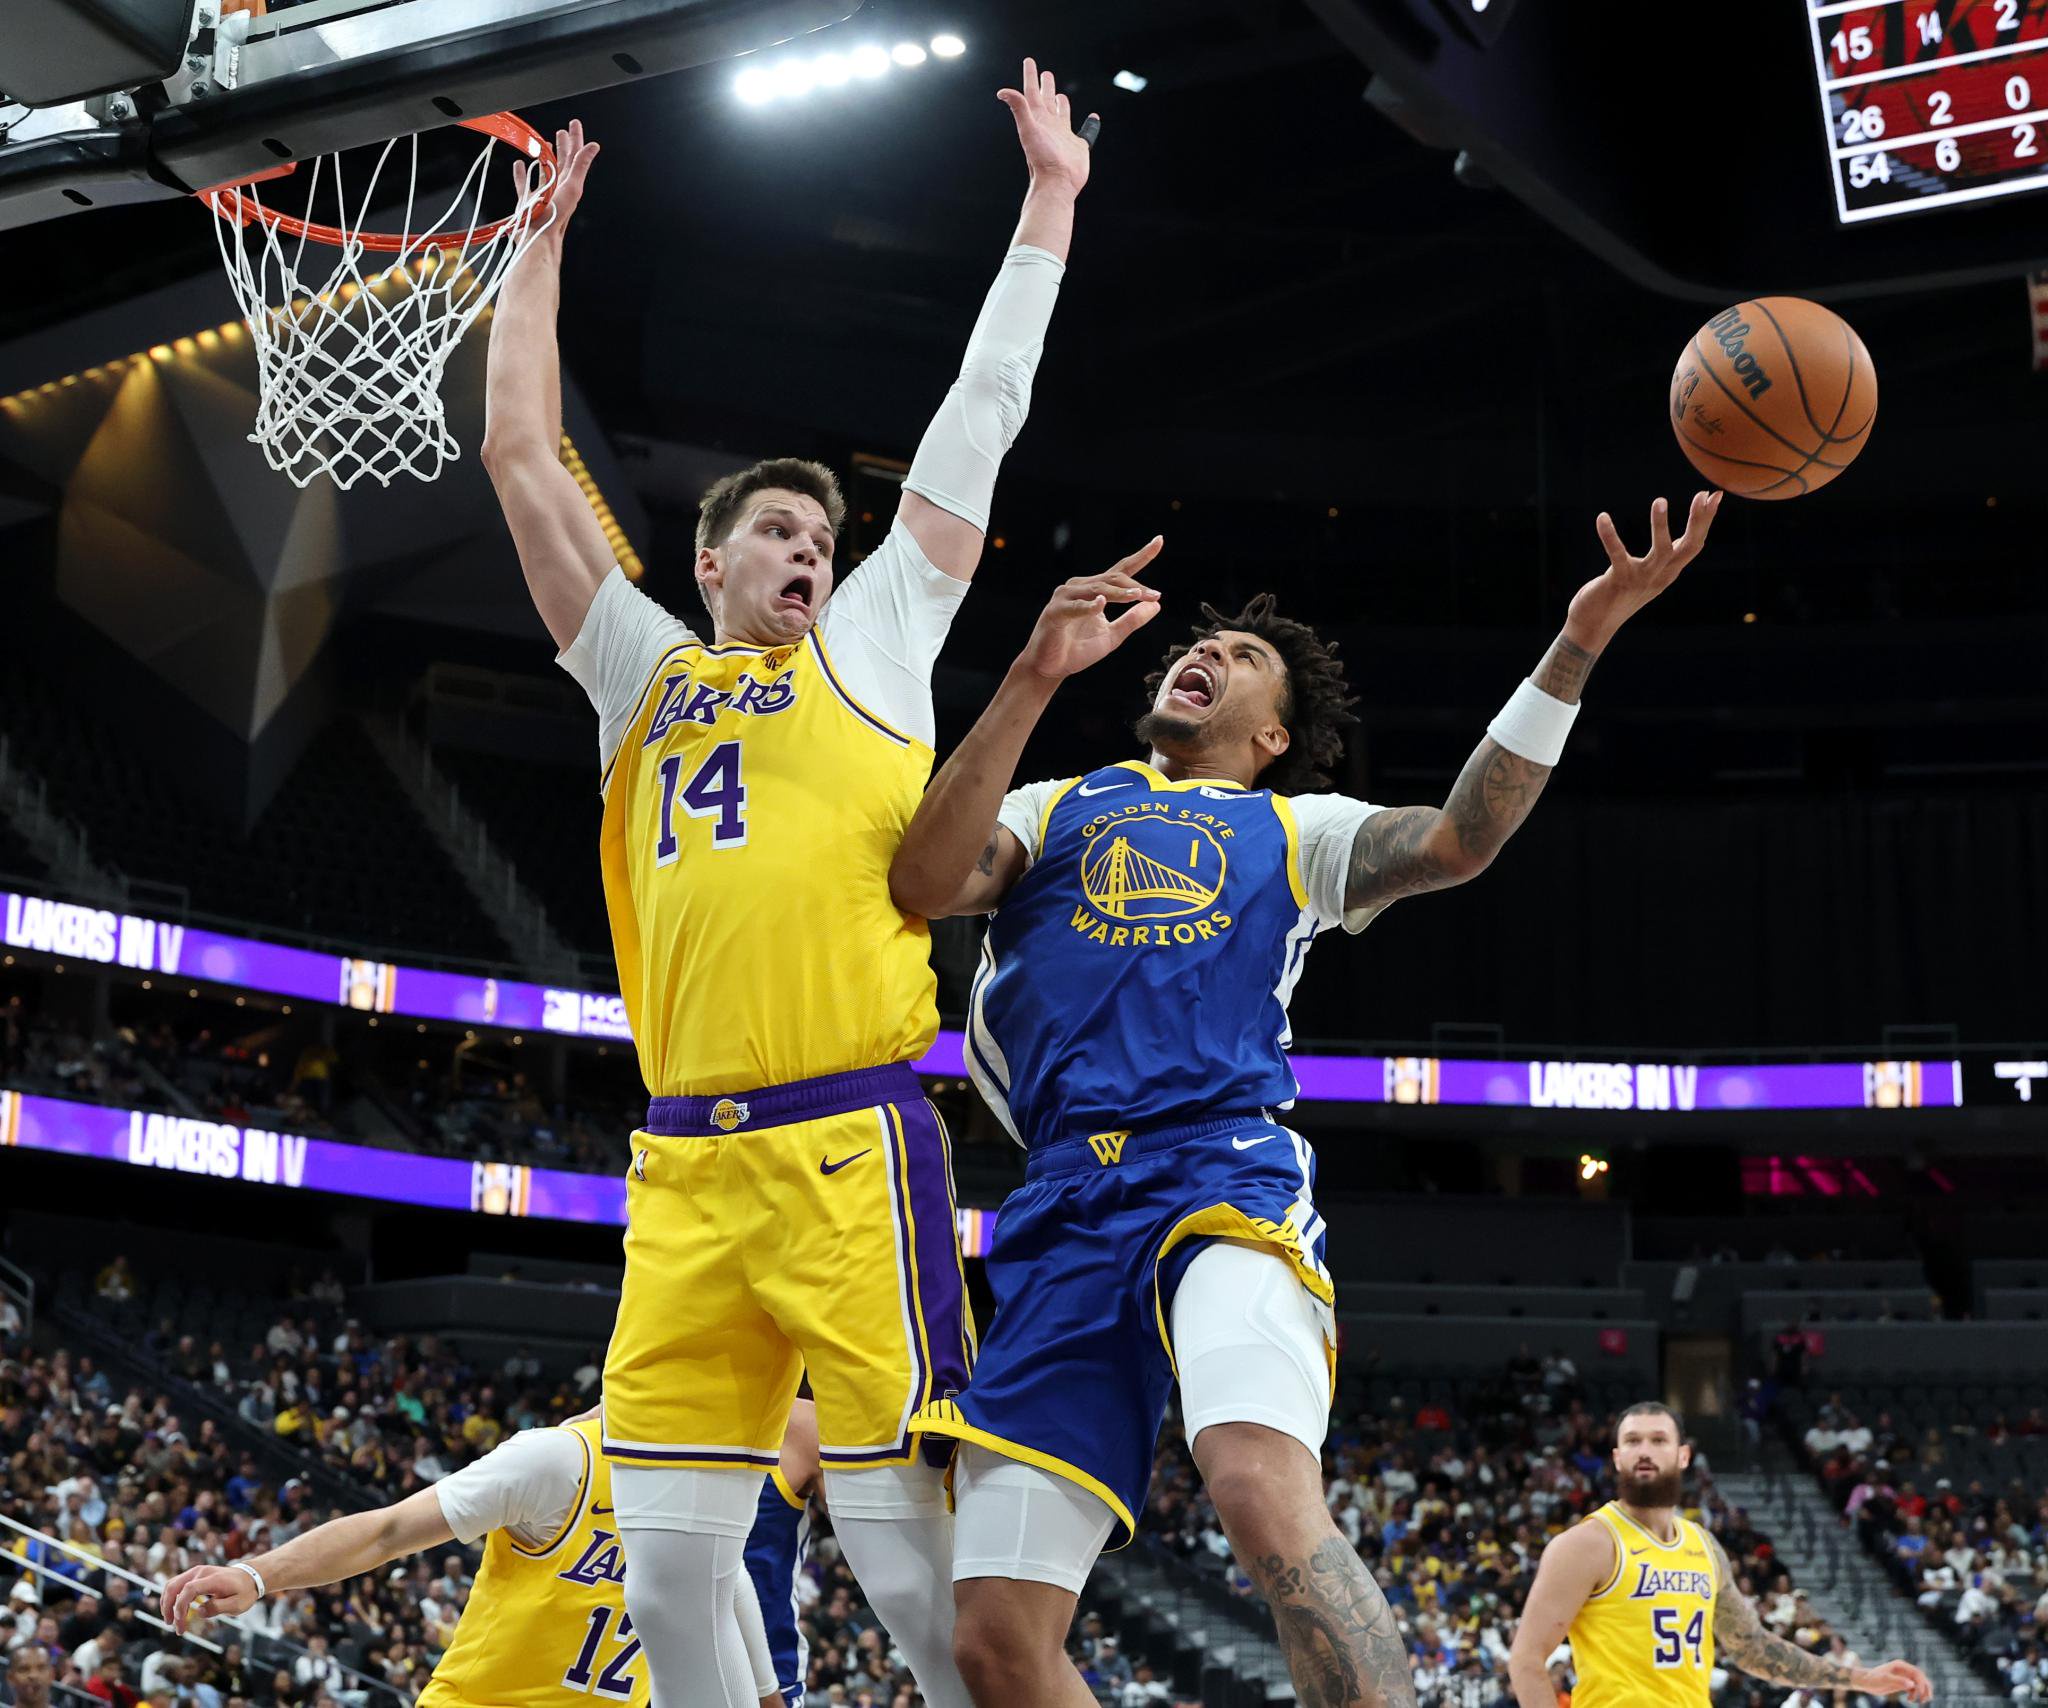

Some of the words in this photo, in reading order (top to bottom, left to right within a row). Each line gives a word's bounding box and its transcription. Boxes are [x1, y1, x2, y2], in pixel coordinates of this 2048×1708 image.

[1830, 26, 1873, 63] 15
[1916, 10, 1943, 46] 14
[1993, 0, 2020, 31] 2
[1841, 105, 1885, 143] 26
[1927, 90, 1954, 126] 2
[2005, 76, 2031, 110] 0
[1848, 151, 1891, 188] 54
[1935, 137, 1961, 171] 6
[2011, 123, 2038, 158] 2
[655, 740, 748, 870] 14
[1081, 802, 1170, 838] GOLDEN
[1178, 808, 1236, 841] STATE
[1189, 839, 1200, 868] 1
[5, 893, 118, 963] LAKERS
[118, 914, 156, 971] IN
[158, 922, 185, 975] V
[1069, 904, 1233, 946] WARRIORS
[1529, 1060, 1633, 1110] LAKERS
[1636, 1063, 1671, 1111] IN
[1672, 1064, 1698, 1111] V
[128, 1110, 240, 1179] LAKERS
[242, 1127, 279, 1184] IN
[281, 1134, 307, 1188] V
[1629, 1563, 1712, 1600] LAKERS
[561, 1605, 644, 1702] 12
[1652, 1607, 1706, 1669] 54
